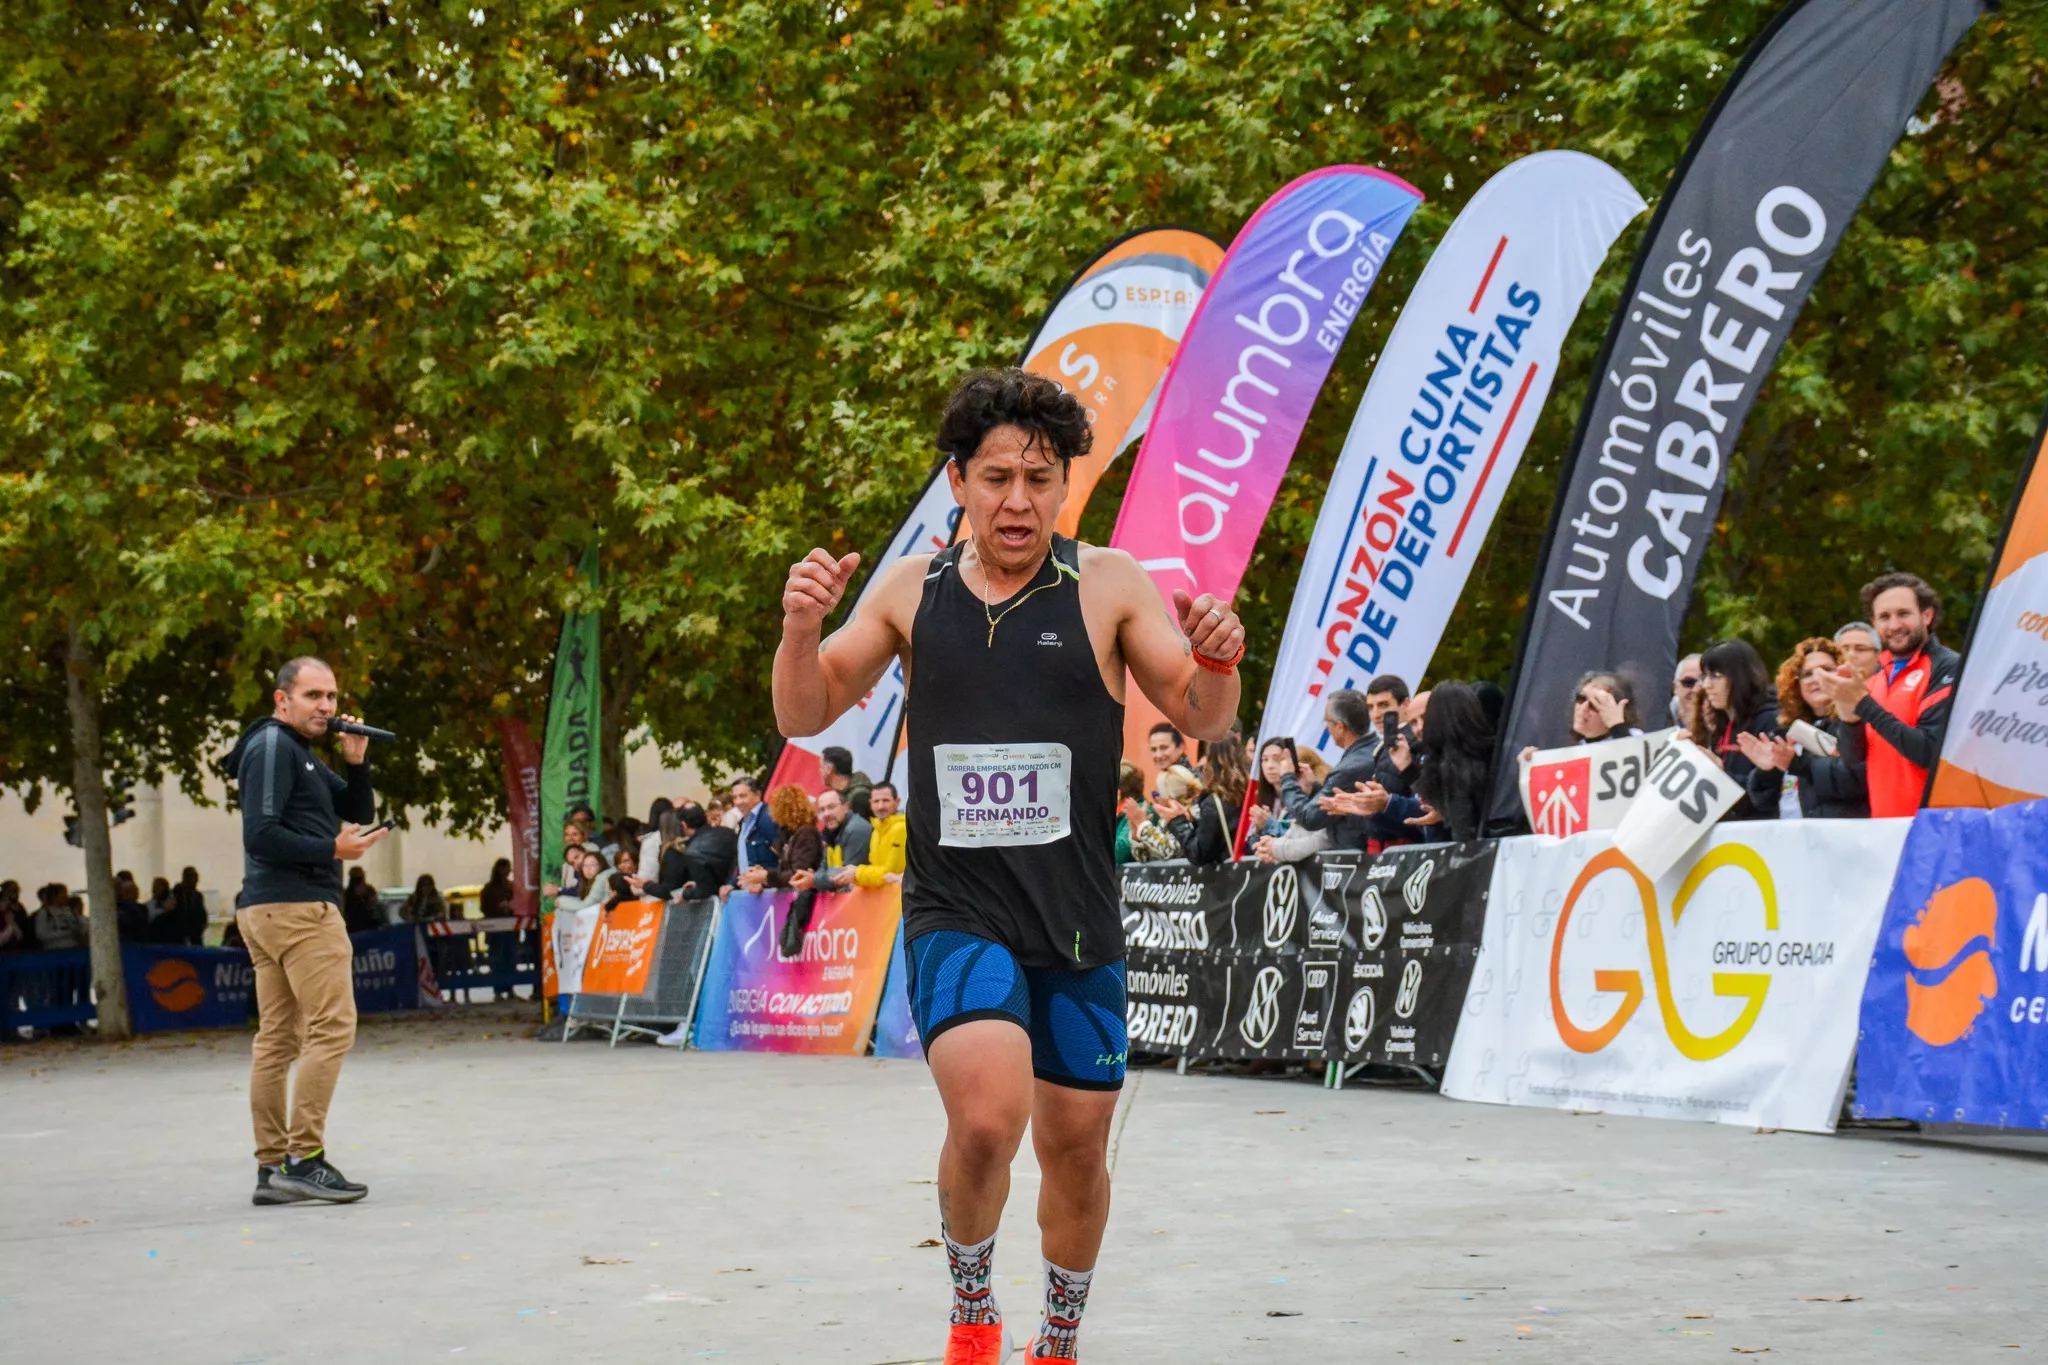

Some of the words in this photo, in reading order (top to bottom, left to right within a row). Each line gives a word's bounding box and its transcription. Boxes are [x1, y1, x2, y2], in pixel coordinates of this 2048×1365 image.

[1125, 286, 1193, 305] ESPIA
[1314, 230, 1392, 355] ENERGÍA
[1178, 209, 1365, 545] alumbra
[1399, 322, 1479, 466] CUNA
[1626, 185, 1828, 600] CABRERO
[1548, 228, 1714, 630] Automóviles
[1346, 599, 1398, 676] DE
[1379, 280, 1542, 602] DEPORTISTAS
[947, 764, 976, 772] CARRERA
[977, 763, 1016, 772] EMPRESAS
[1018, 762, 1050, 771] MONZÓN
[1050, 762, 1062, 770] CM
[961, 770, 1038, 805] 901
[957, 806, 1049, 822] FERNANDO
[1121, 875, 1204, 905] Automóviles
[777, 918, 858, 964] mbra
[1122, 910, 1210, 951] CABRERO
[1713, 941, 1772, 965] GRUPO
[1777, 941, 1834, 966] GRACIA
[1127, 963, 1190, 997] omóviles
[2010, 996, 2048, 1025] ce
